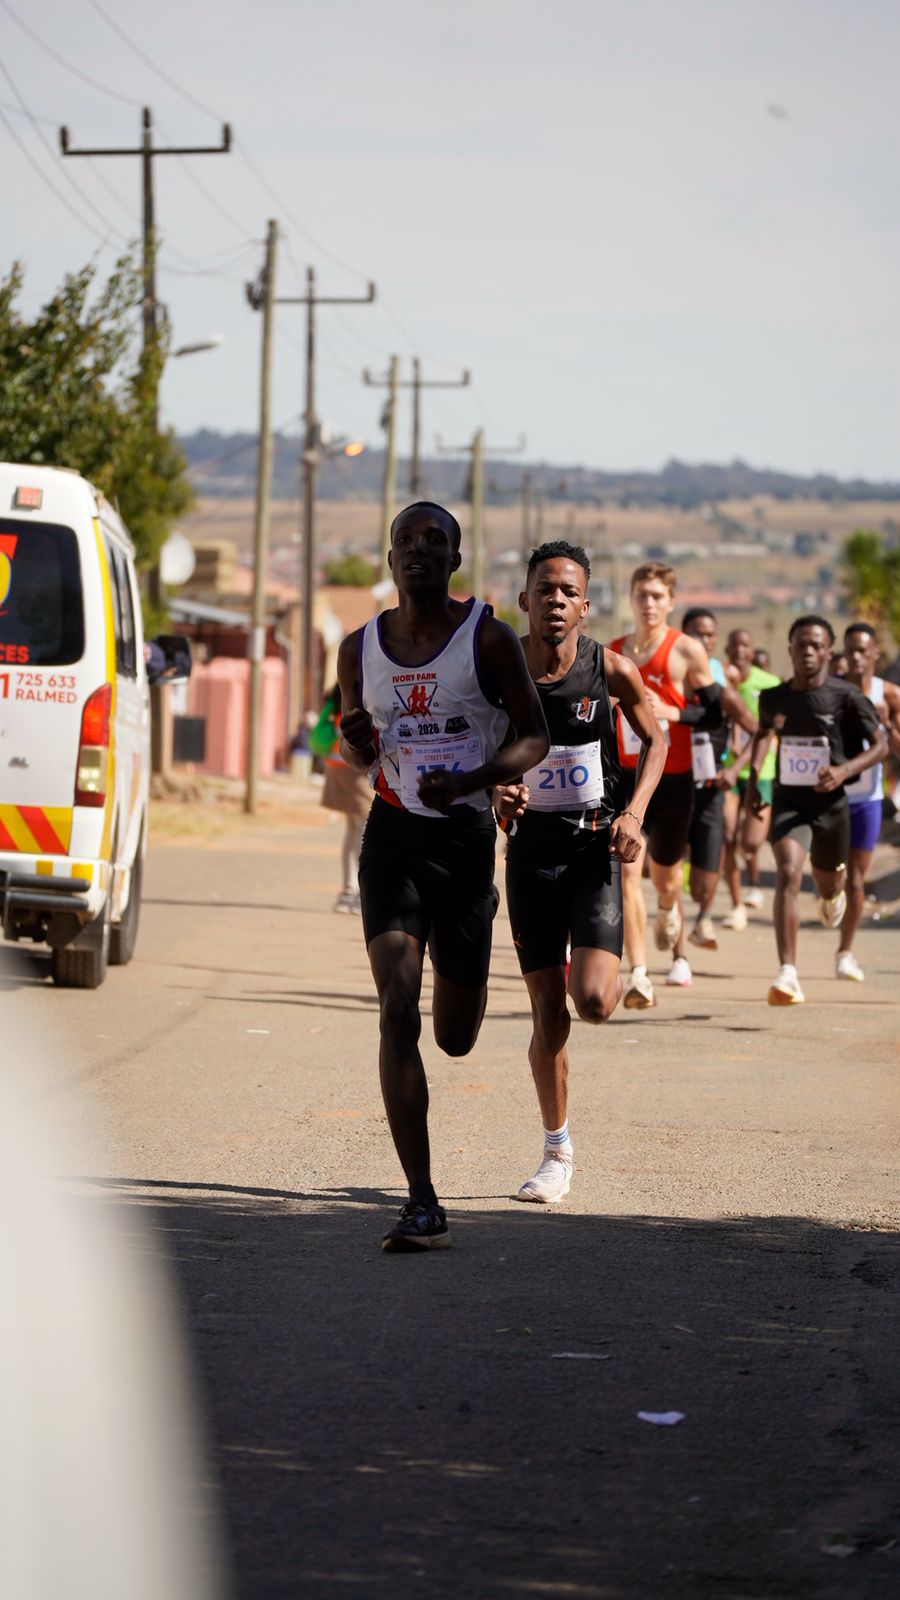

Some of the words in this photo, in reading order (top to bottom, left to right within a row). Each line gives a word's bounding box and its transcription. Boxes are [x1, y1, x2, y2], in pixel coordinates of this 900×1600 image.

[16, 673, 43, 687] 725
[48, 675, 76, 688] 633
[392, 673, 415, 683] IVORY
[15, 688, 77, 703] RALMED
[418, 723, 440, 736] 2026
[789, 759, 819, 773] 107
[538, 765, 589, 790] 210
